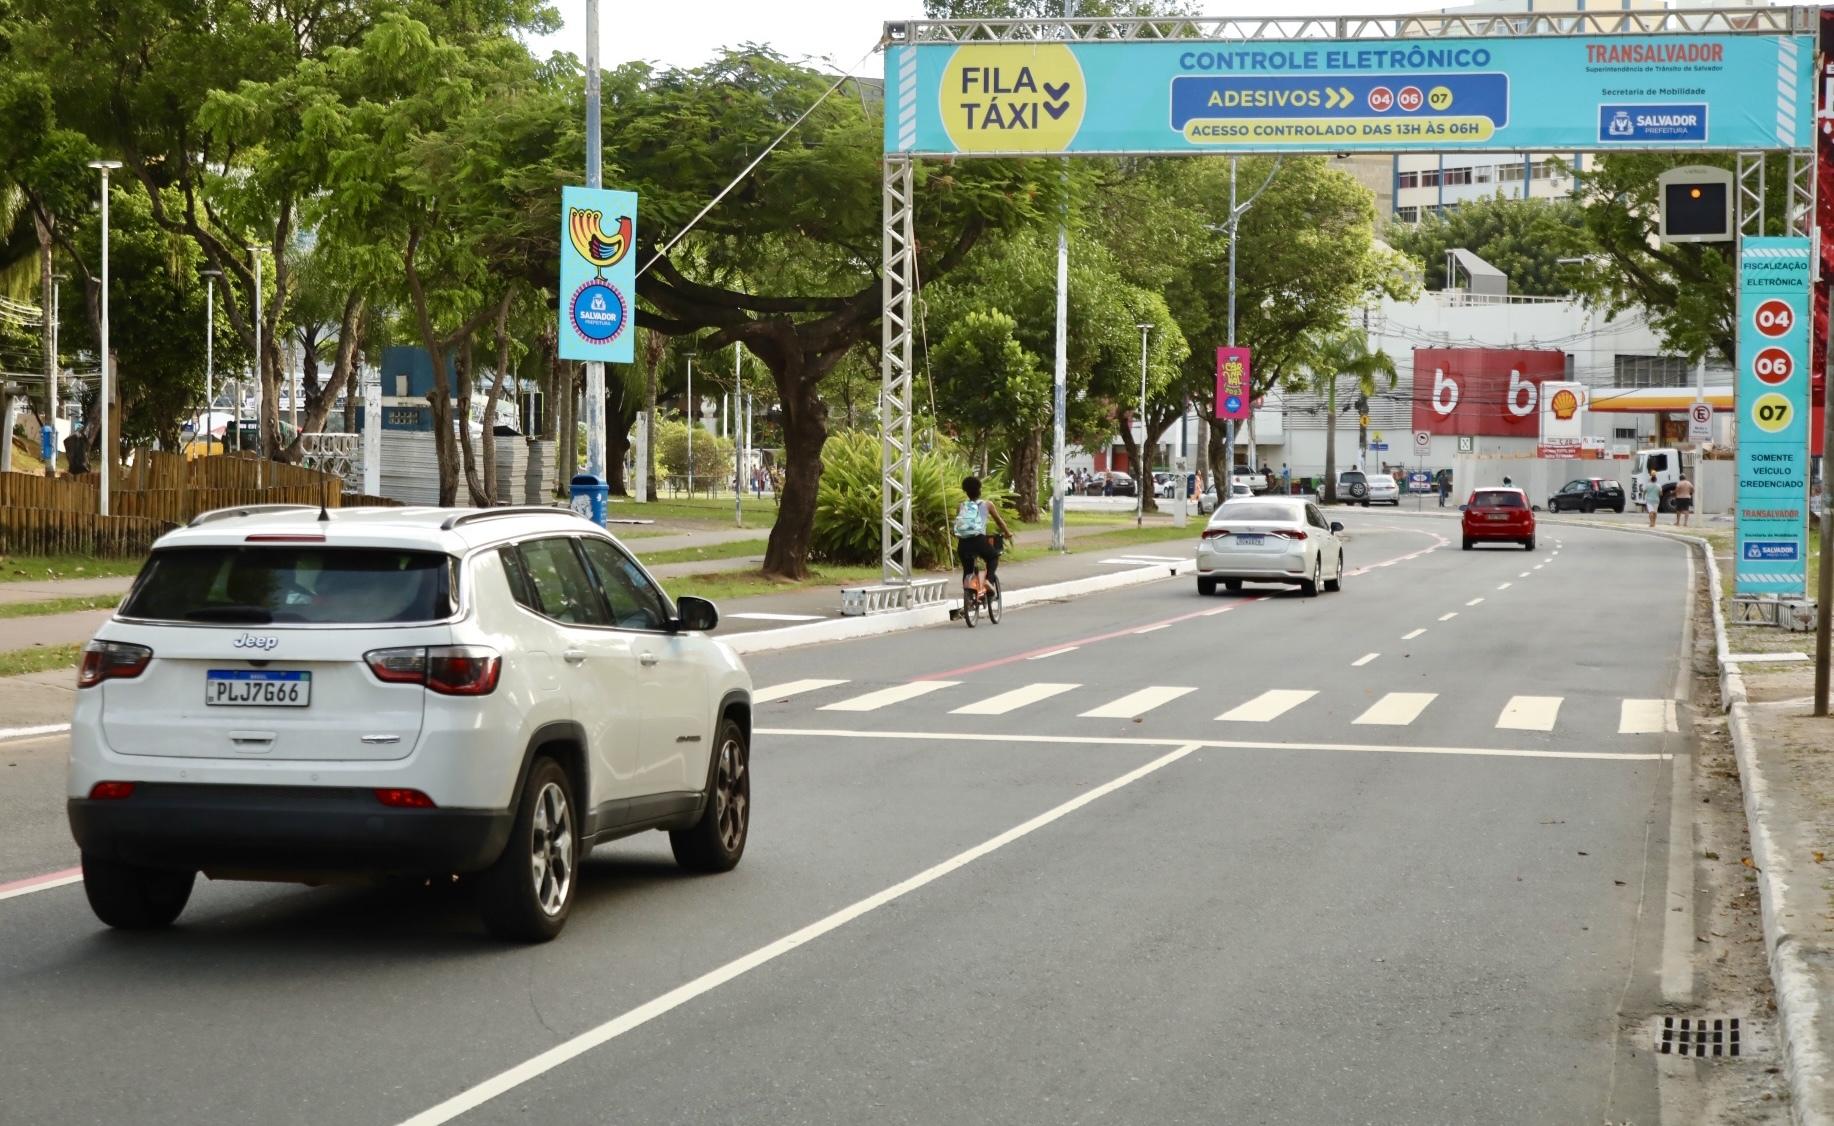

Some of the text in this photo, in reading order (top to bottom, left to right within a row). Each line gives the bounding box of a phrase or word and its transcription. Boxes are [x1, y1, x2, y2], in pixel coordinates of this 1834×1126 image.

[1179, 45, 1492, 71] CONTROLE ELETRÔNICO
[1585, 43, 1724, 64] TRANSALVADOR
[1585, 66, 1643, 74] Superintendência
[961, 66, 1038, 95] FILA
[1207, 90, 1321, 108] ADESIVOS
[1371, 93, 1391, 105] 04
[1400, 93, 1420, 105] 06
[1431, 92, 1448, 105] 07
[1602, 88, 1644, 96] Secretaria
[1659, 87, 1706, 95] Mobilidade
[960, 97, 1039, 130] TÁXI
[1636, 115, 1697, 127] SALVADOR
[1191, 120, 1480, 137] ACESSO CONTROLADO DAS 13H ÀS 06H
[1744, 261, 1808, 272] FISCALIZAÇÃO
[1747, 277, 1803, 287] ELETRÔNICA
[580, 311, 617, 322] SALVADOR
[1759, 311, 1790, 328] 04
[1757, 358, 1788, 375] 06
[1432, 368, 1459, 415] b
[1508, 369, 1538, 416] b
[1759, 405, 1788, 421] 07
[1751, 454, 1794, 462] SOMENTE
[1753, 466, 1792, 475] VEÍCULO
[1740, 480, 1804, 489] CREDENCIADO
[233, 632, 279, 651] Jeep
[216, 682, 299, 702] PLJ7G66
